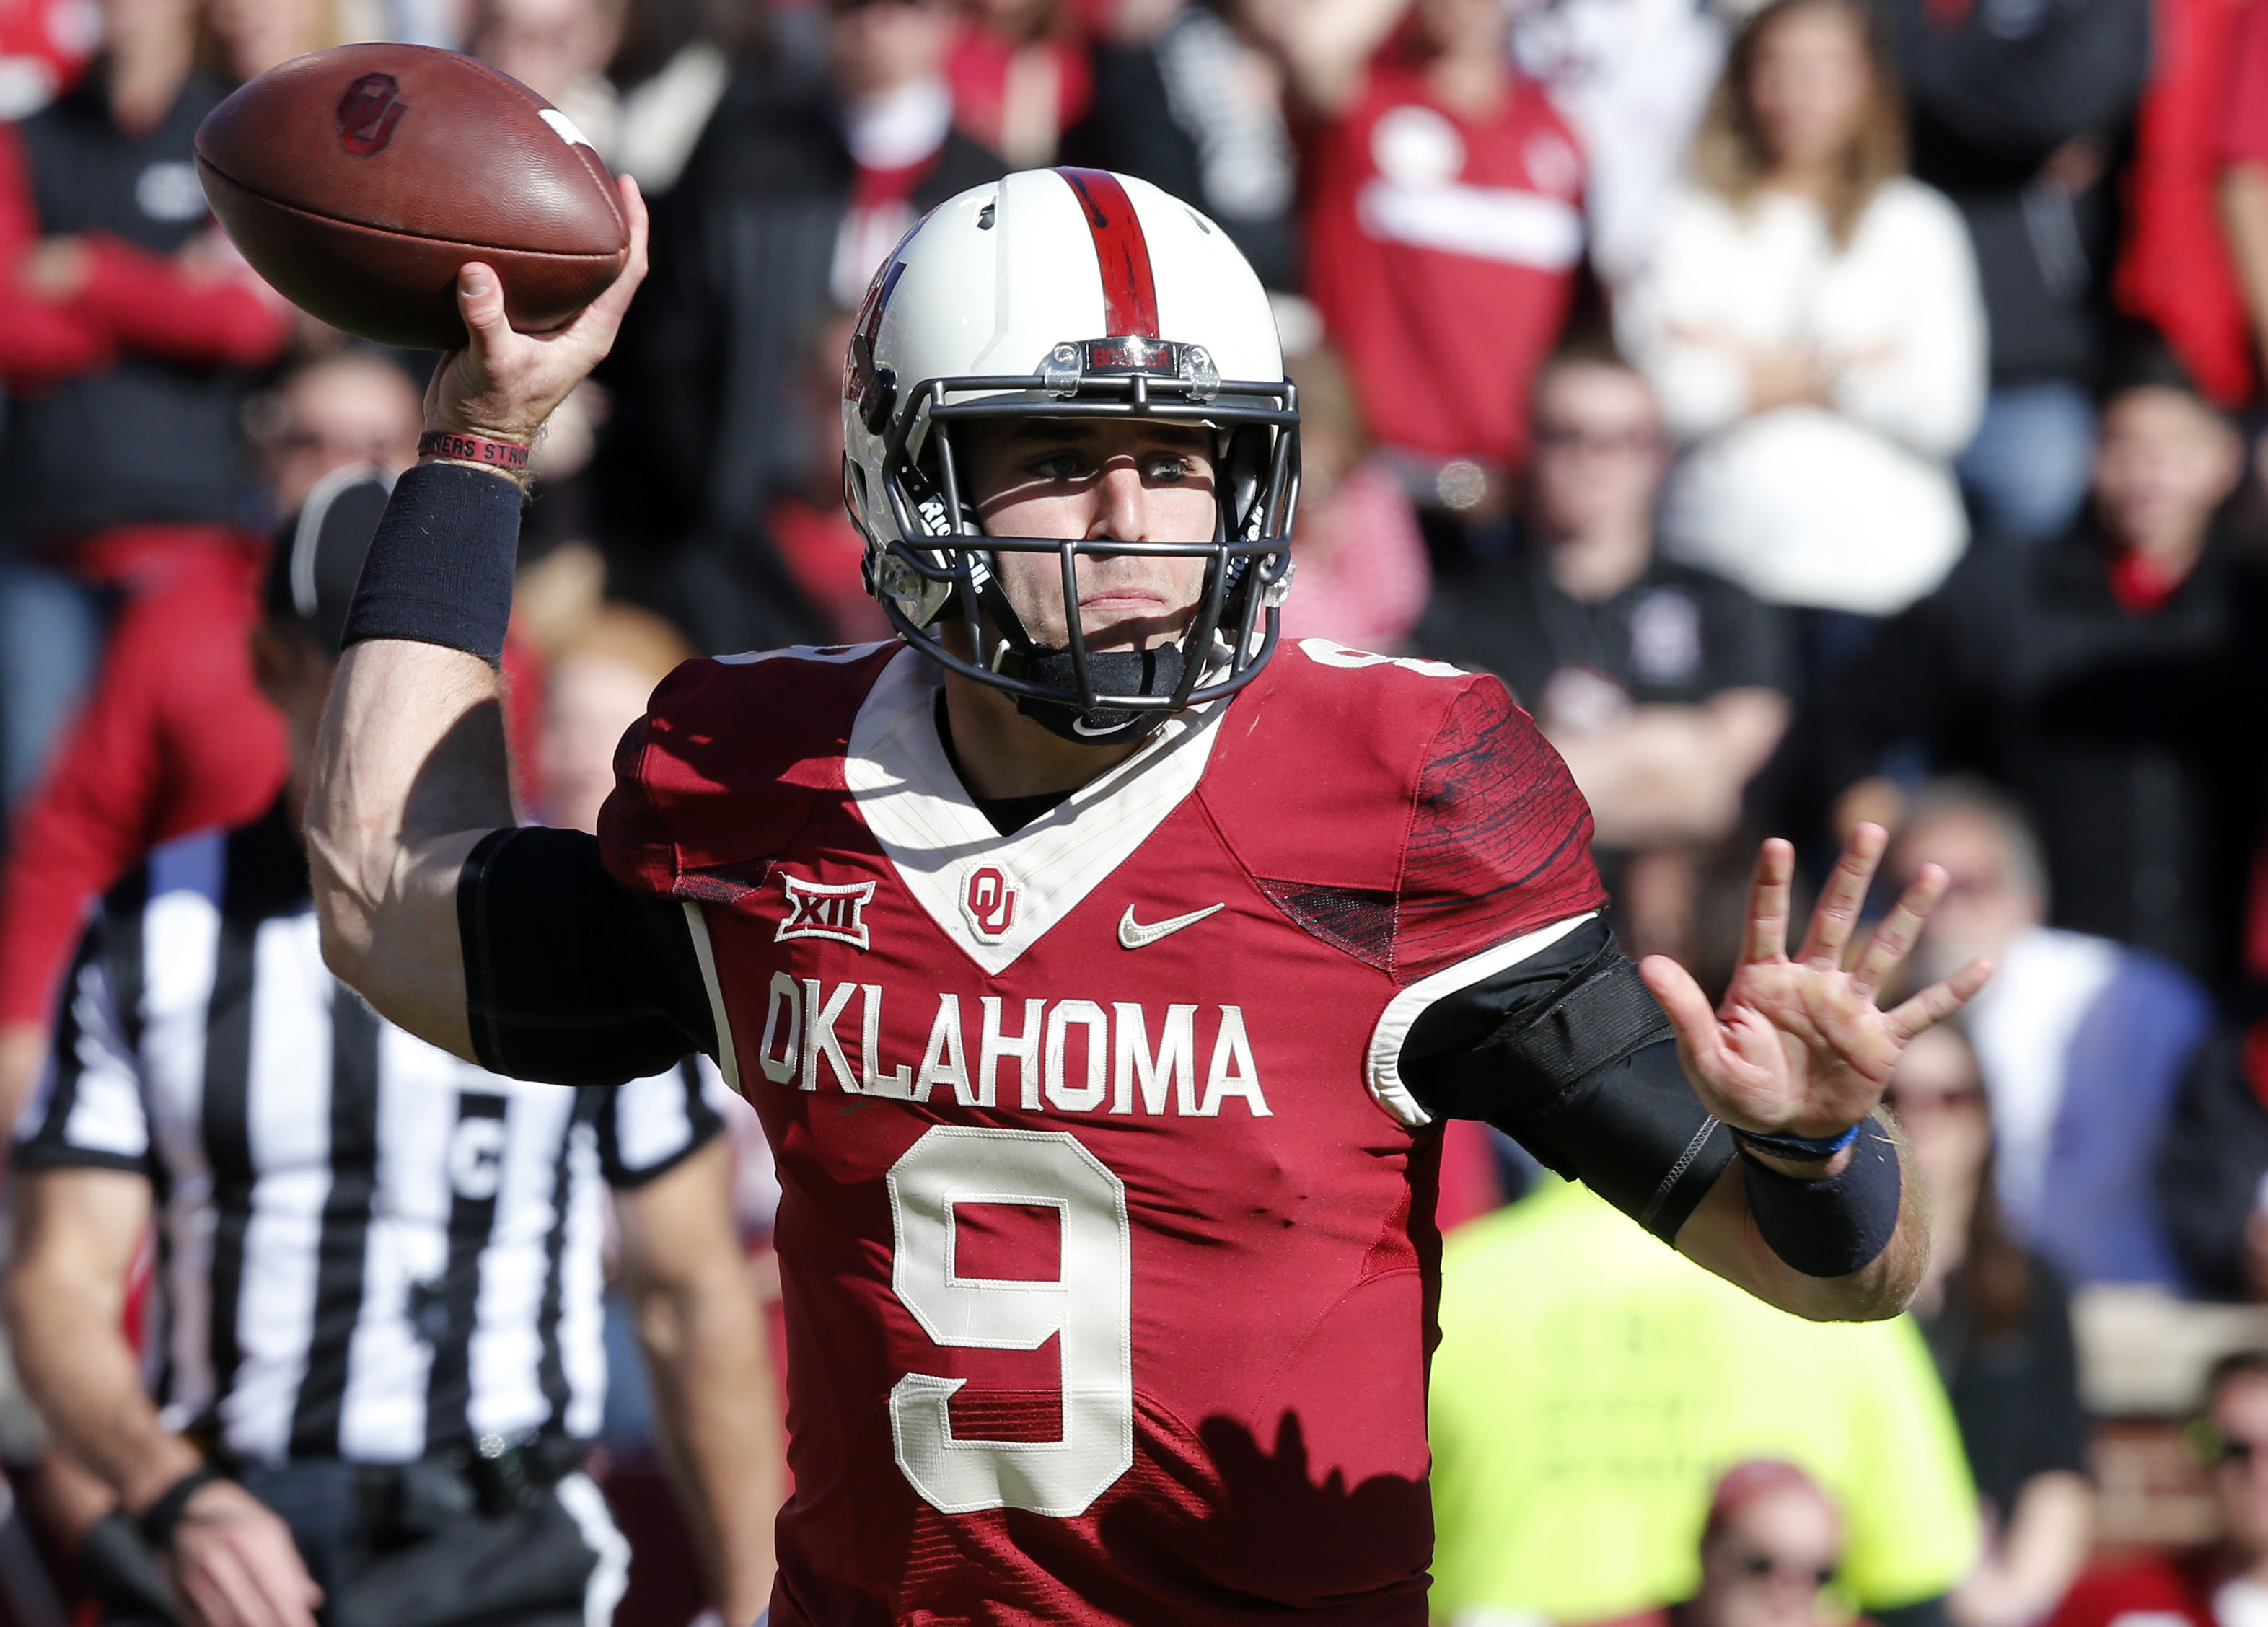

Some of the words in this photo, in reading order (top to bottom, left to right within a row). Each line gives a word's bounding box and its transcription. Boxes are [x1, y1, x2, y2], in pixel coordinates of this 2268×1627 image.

[335, 72, 408, 156] OU
[783, 886, 867, 940] XII
[967, 867, 1016, 935] OU
[759, 971, 1275, 1118] OKLAHOMA
[886, 1124, 1134, 1517] 9
